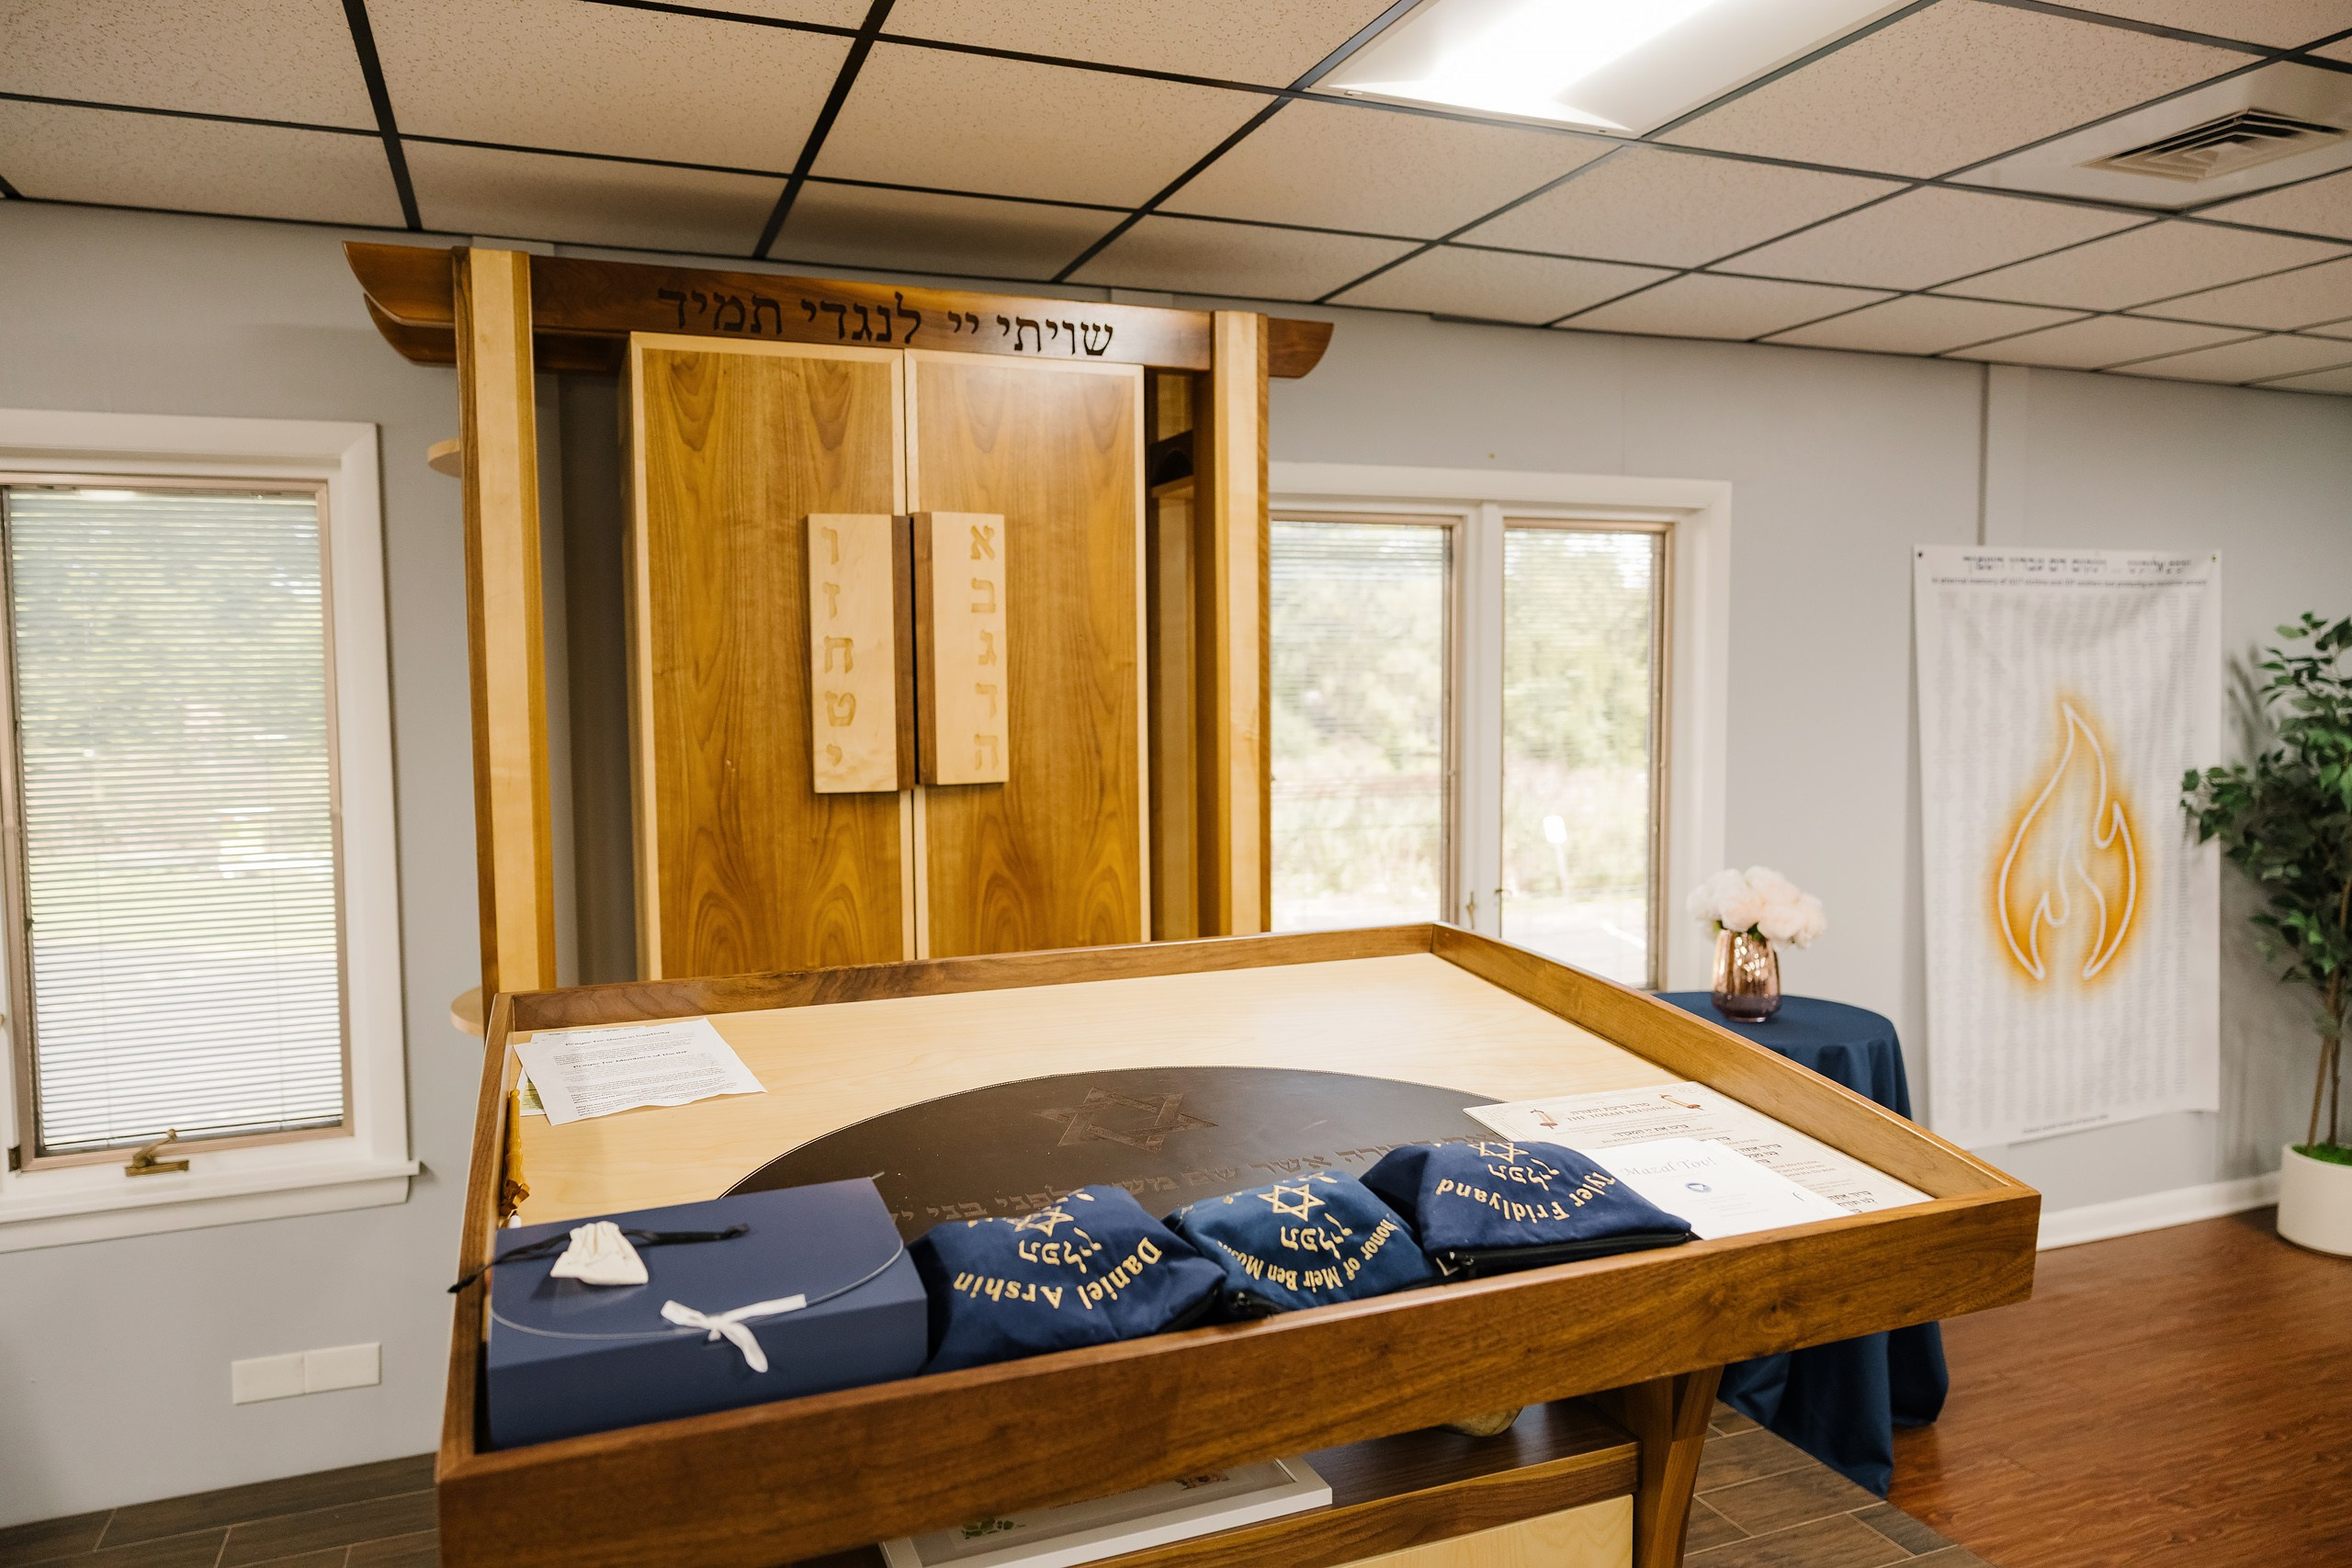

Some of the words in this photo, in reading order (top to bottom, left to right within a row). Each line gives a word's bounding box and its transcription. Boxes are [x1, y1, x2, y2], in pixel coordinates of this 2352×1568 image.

[657, 288, 784, 336] תמיד
[800, 291, 922, 344] לנגדי
[947, 310, 980, 334] יי
[996, 314, 1114, 356] שויתי
[1620, 1161, 1676, 1177] Mazal
[1676, 1156, 1718, 1170] Tov!
[1435, 1179, 1570, 1224] Fridlyand
[1568, 1171, 1617, 1208] Tyler
[1077, 1236, 1163, 1310] Daniel
[1267, 1264, 1299, 1292] Ben
[1303, 1266, 1344, 1292] Meir
[1342, 1257, 1362, 1280] of
[953, 1271, 1063, 1310] Arshin
